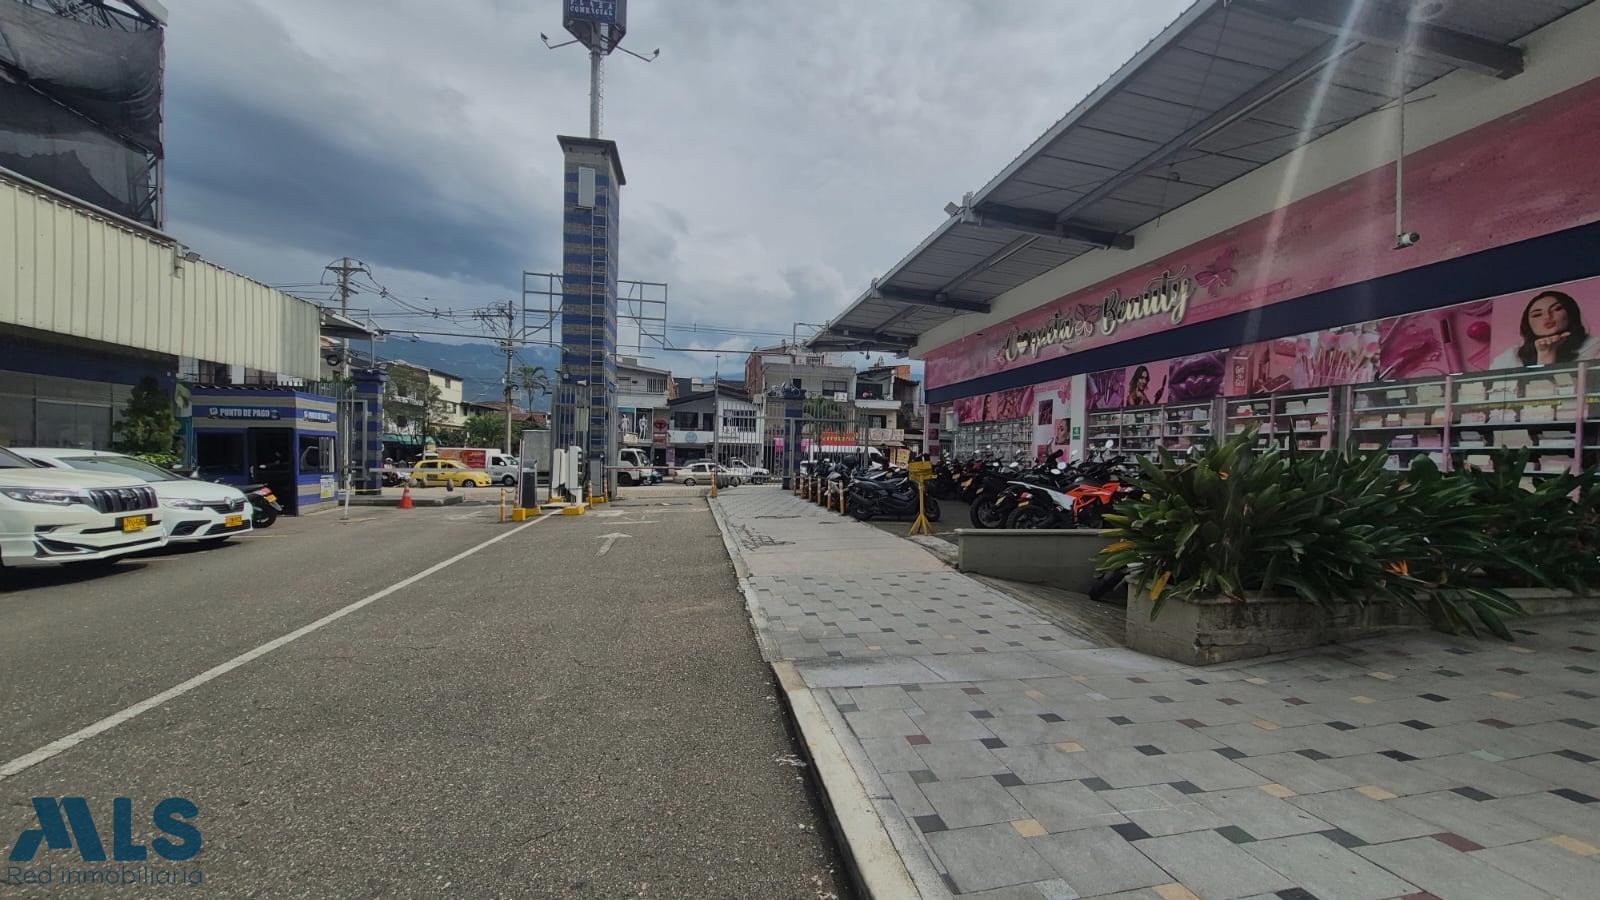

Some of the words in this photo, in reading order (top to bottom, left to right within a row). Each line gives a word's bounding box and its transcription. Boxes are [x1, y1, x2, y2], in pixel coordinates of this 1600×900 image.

[1101, 266, 1190, 335] Beauty
[219, 408, 241, 417] PUNTO
[243, 408, 251, 417] DE
[252, 408, 270, 417] PAGO
